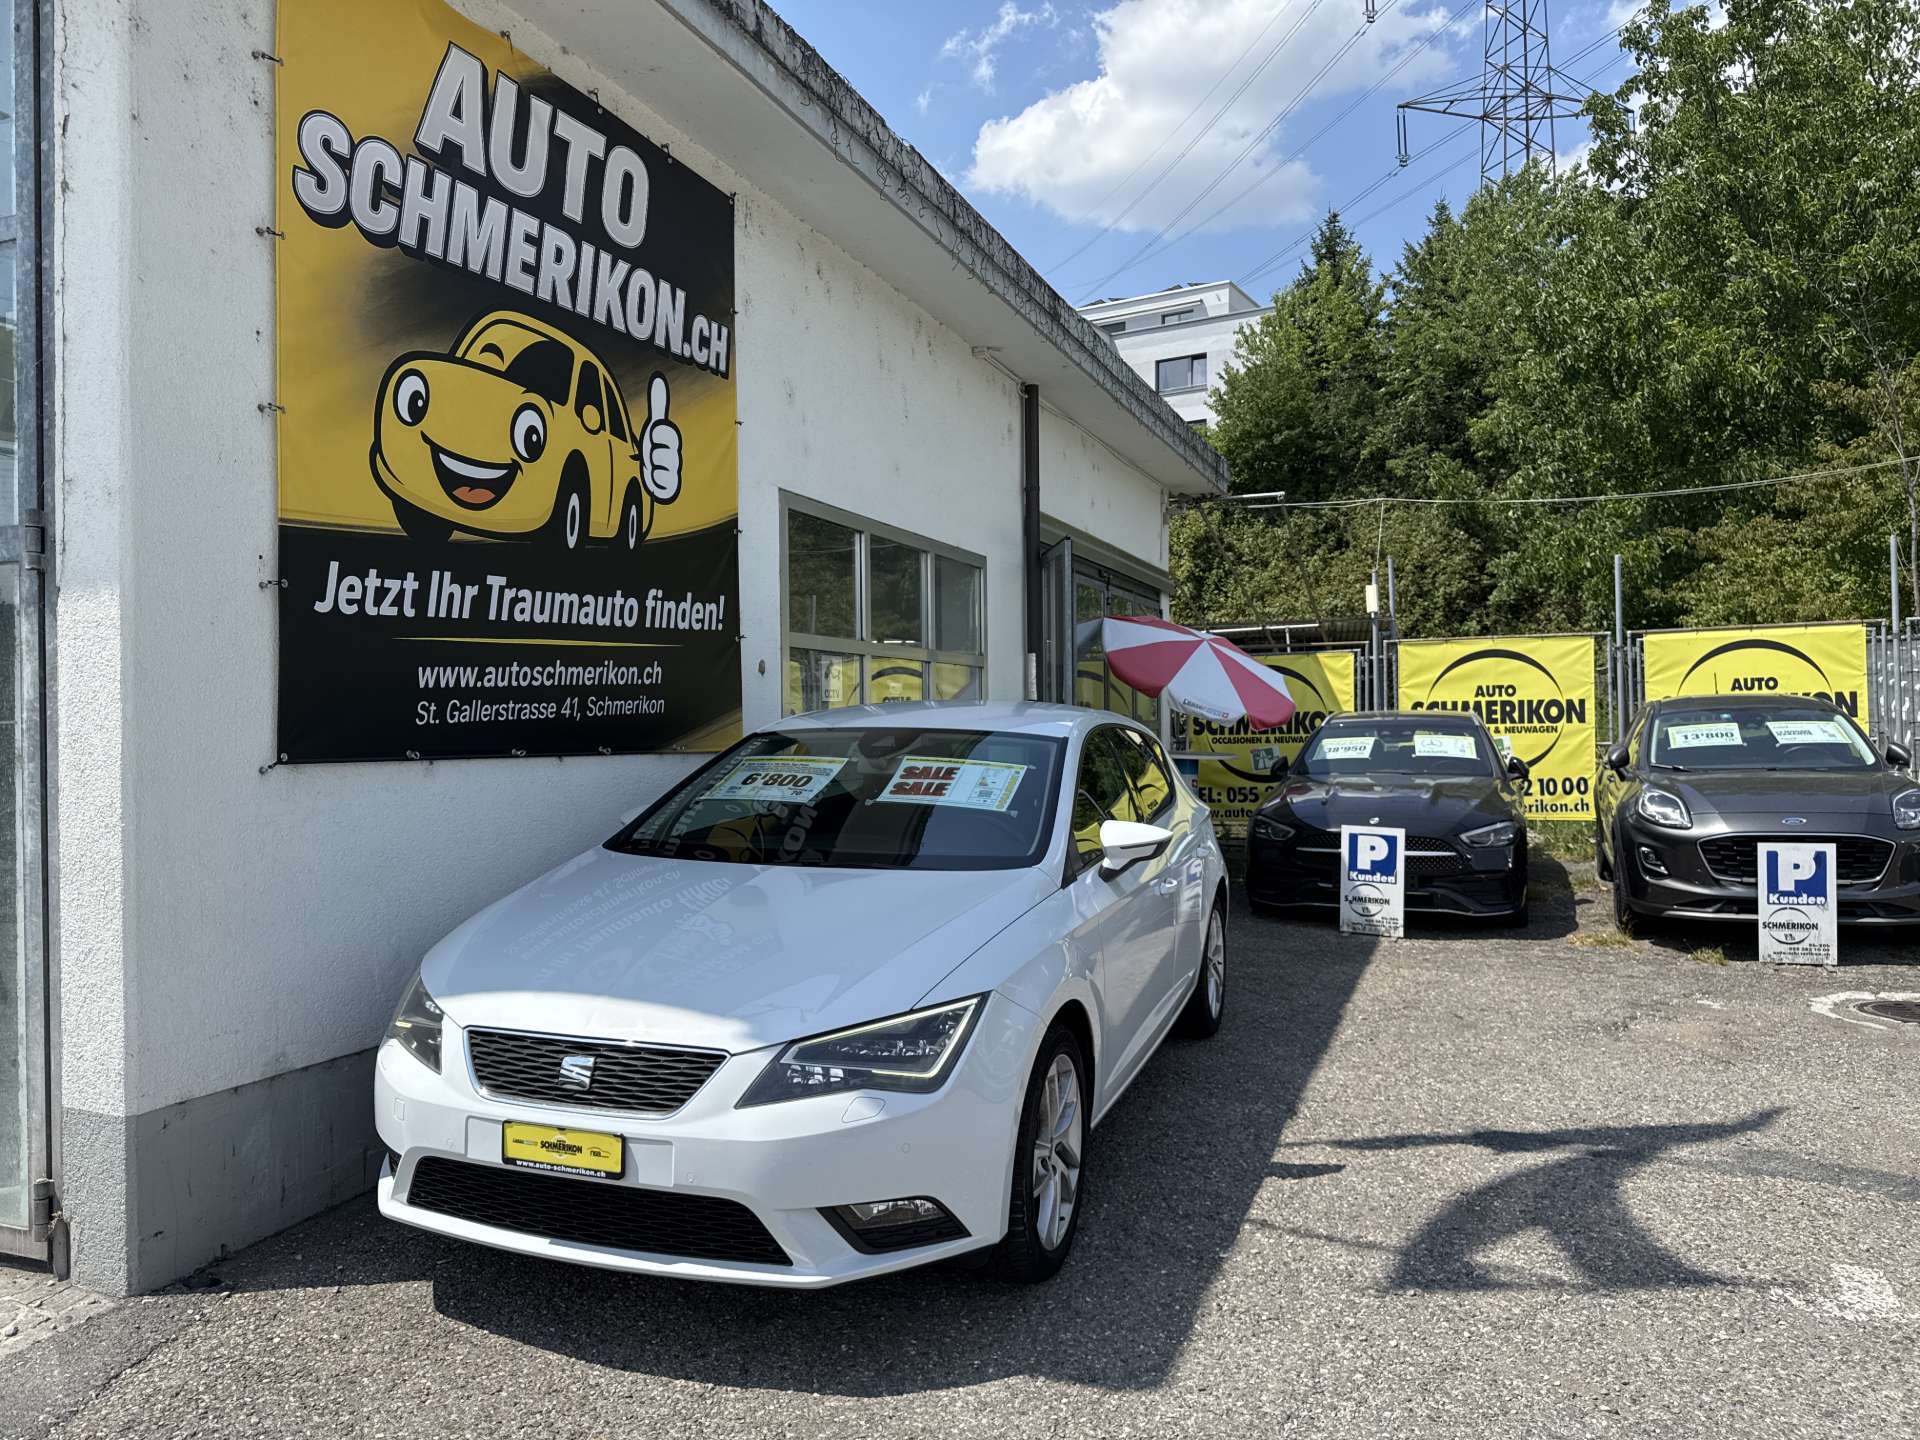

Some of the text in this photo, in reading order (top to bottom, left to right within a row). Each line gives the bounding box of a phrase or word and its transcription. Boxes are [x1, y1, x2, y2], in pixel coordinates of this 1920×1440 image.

[415, 44, 650, 249] AUTO
[294, 112, 729, 374] SCHMERIKON.CH
[313, 561, 725, 631] Jetzt Ihr Traumauto finden!
[418, 660, 662, 688] www.autoschmerikon.ch
[1474, 684, 1517, 698] AUTO
[1731, 677, 1778, 691] AUTO
[416, 695, 665, 725] St. Gallerstrasse 41, Schmerikon
[1504, 725, 1558, 734] NEUWAGEN
[1212, 736, 1262, 745] OCCASIONEN
[1265, 736, 1272, 744] &
[741, 772, 813, 788] 6'800
[900, 766, 960, 780] SALE
[889, 782, 952, 796] SALE
[1227, 786, 1260, 804] 055
[1349, 871, 1396, 883] Kunden
[1768, 893, 1826, 905] Kunden
[1762, 921, 1819, 930] SCHMERIKON
[540, 1140, 583, 1154] SCHMERIKON
[516, 1160, 607, 1178] www.auto-schmerikon.ch
